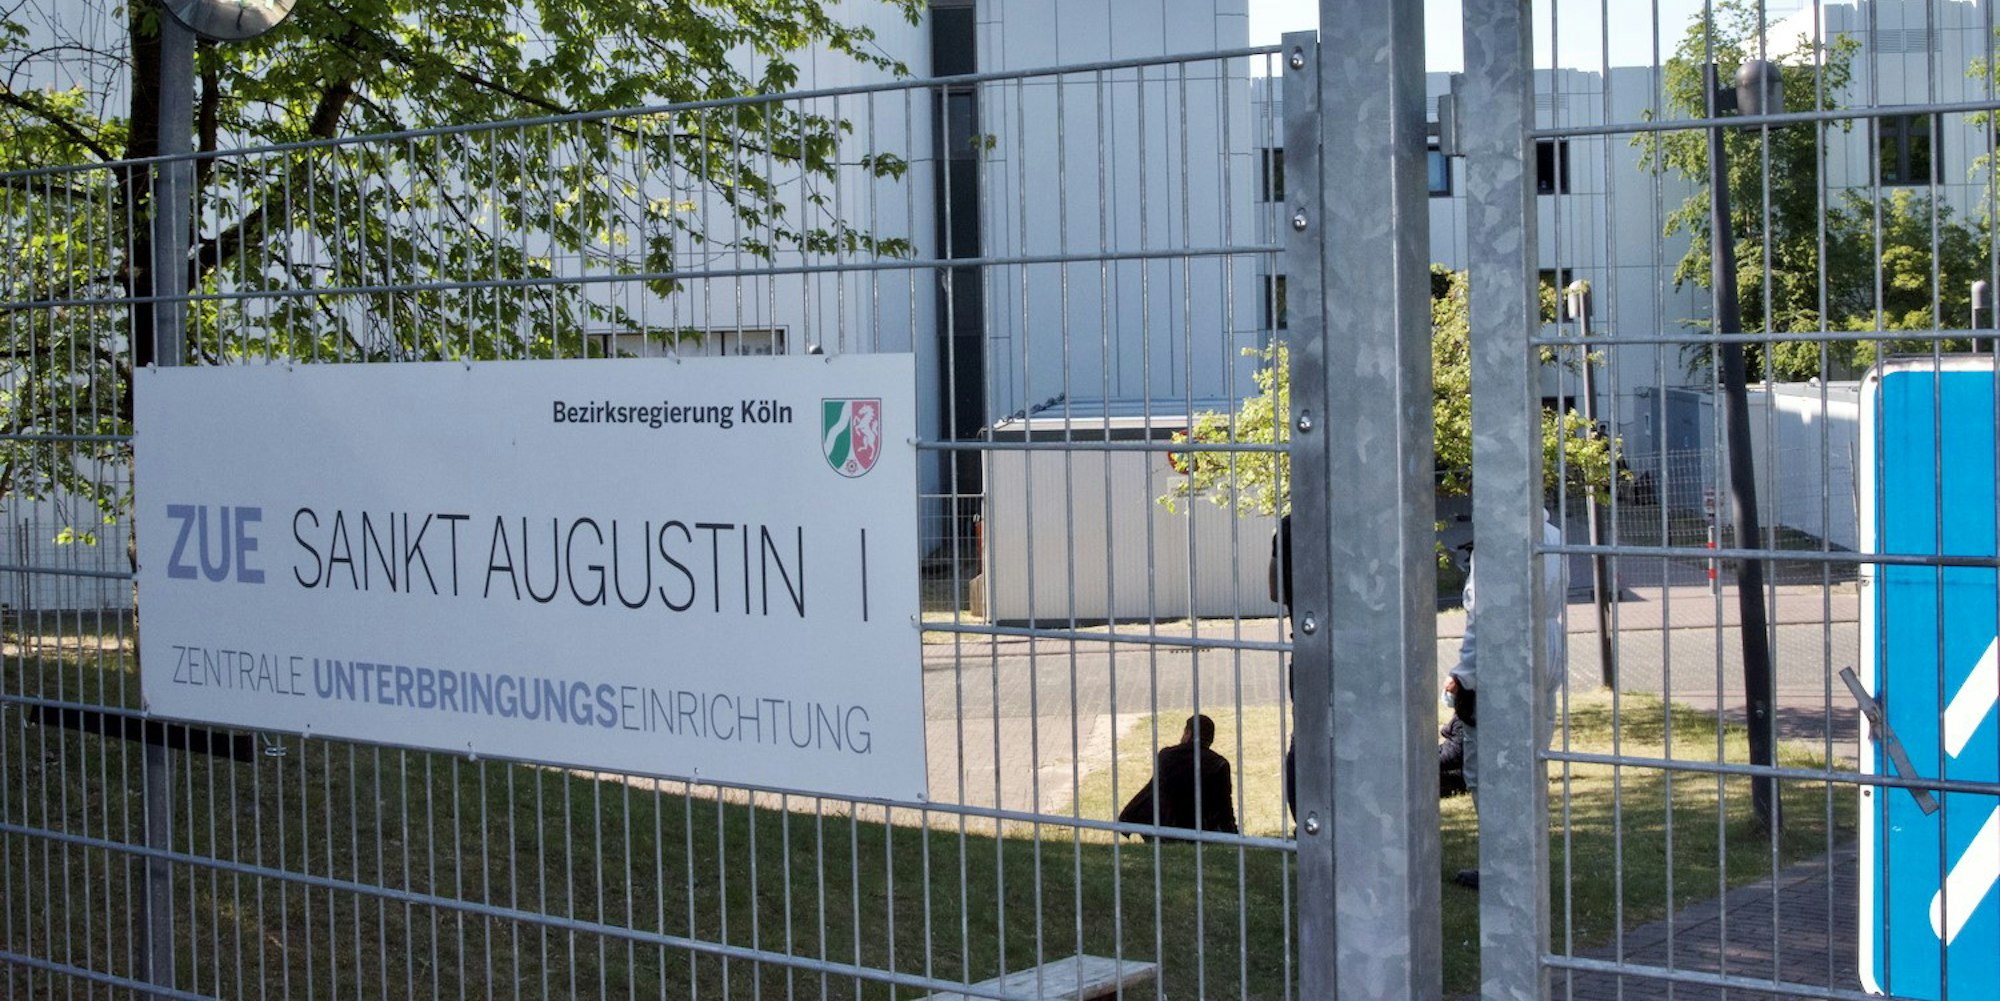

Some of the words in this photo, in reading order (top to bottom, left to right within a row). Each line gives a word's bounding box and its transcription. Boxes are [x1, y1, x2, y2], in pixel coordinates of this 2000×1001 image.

[552, 400, 734, 430] Bezirksregierung
[740, 399, 793, 425] Köln
[167, 504, 265, 584] ZUE
[292, 507, 471, 597] SANKT
[483, 515, 805, 619] AUGUSTIN
[172, 645, 306, 697] ZENTRALE
[313, 657, 872, 755] UNTERBRINGUNGSEINRICHTUNG
